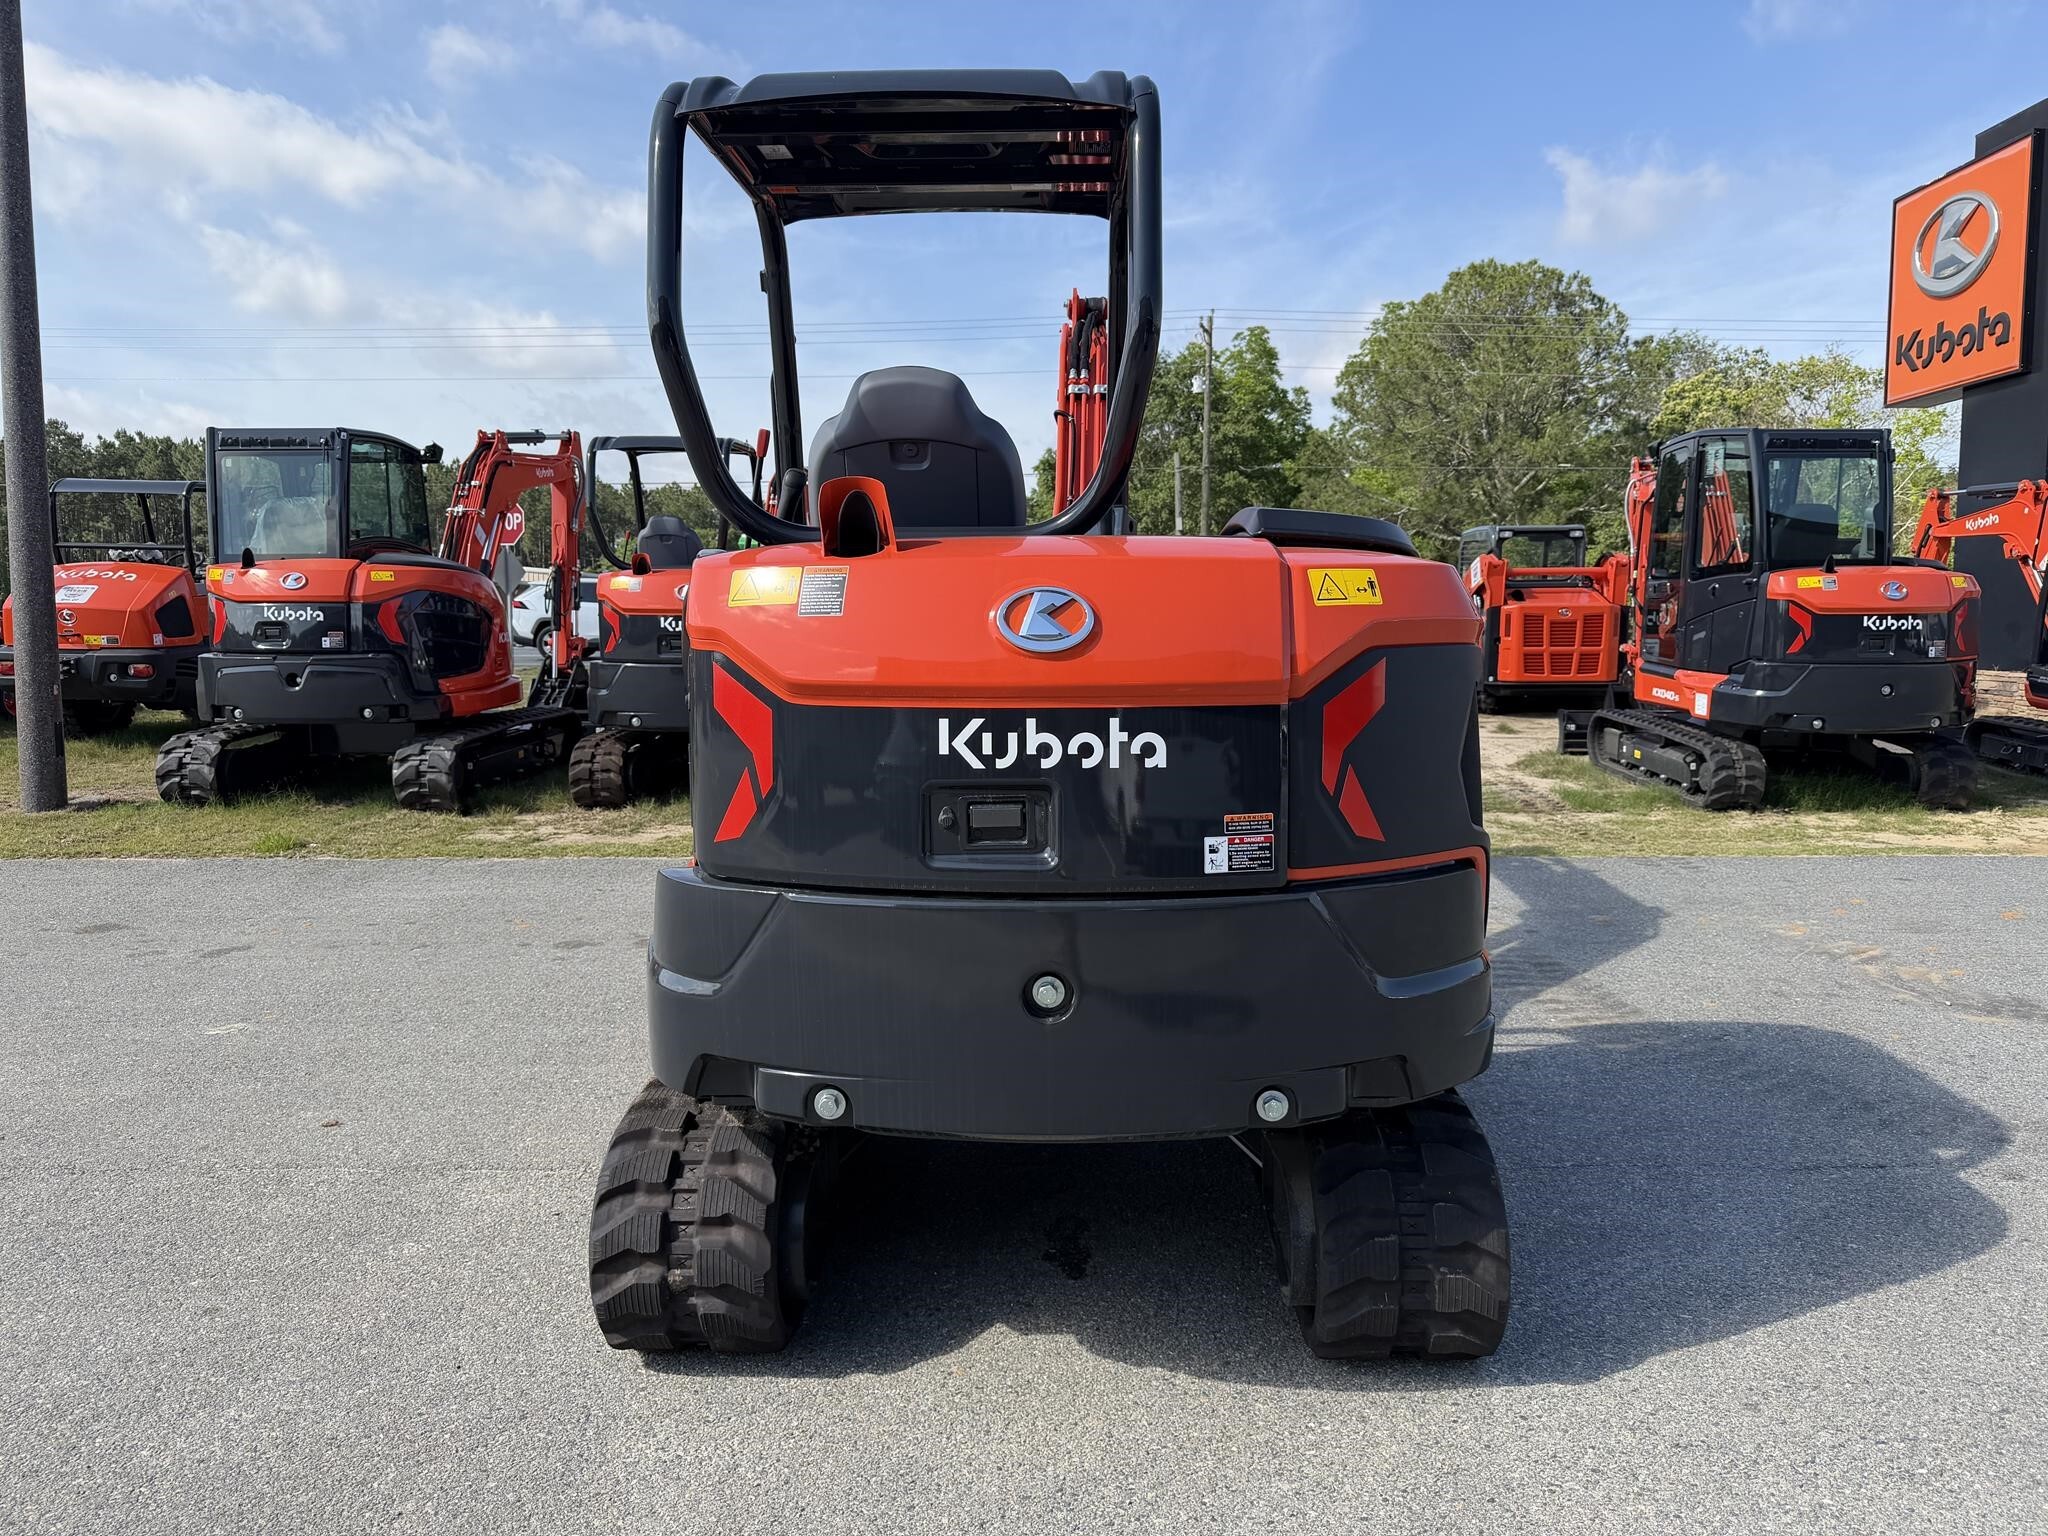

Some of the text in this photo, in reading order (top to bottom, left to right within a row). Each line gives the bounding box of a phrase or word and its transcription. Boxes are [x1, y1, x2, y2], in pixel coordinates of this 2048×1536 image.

[1895, 306, 2011, 373] Kubota
[505, 513, 522, 530] OP
[1965, 513, 1999, 531] Kubota
[56, 568, 137, 581] Kubota
[263, 606, 324, 621] Kubota
[1863, 615, 1922, 631] Kubota
[938, 717, 1167, 770] Kubota
